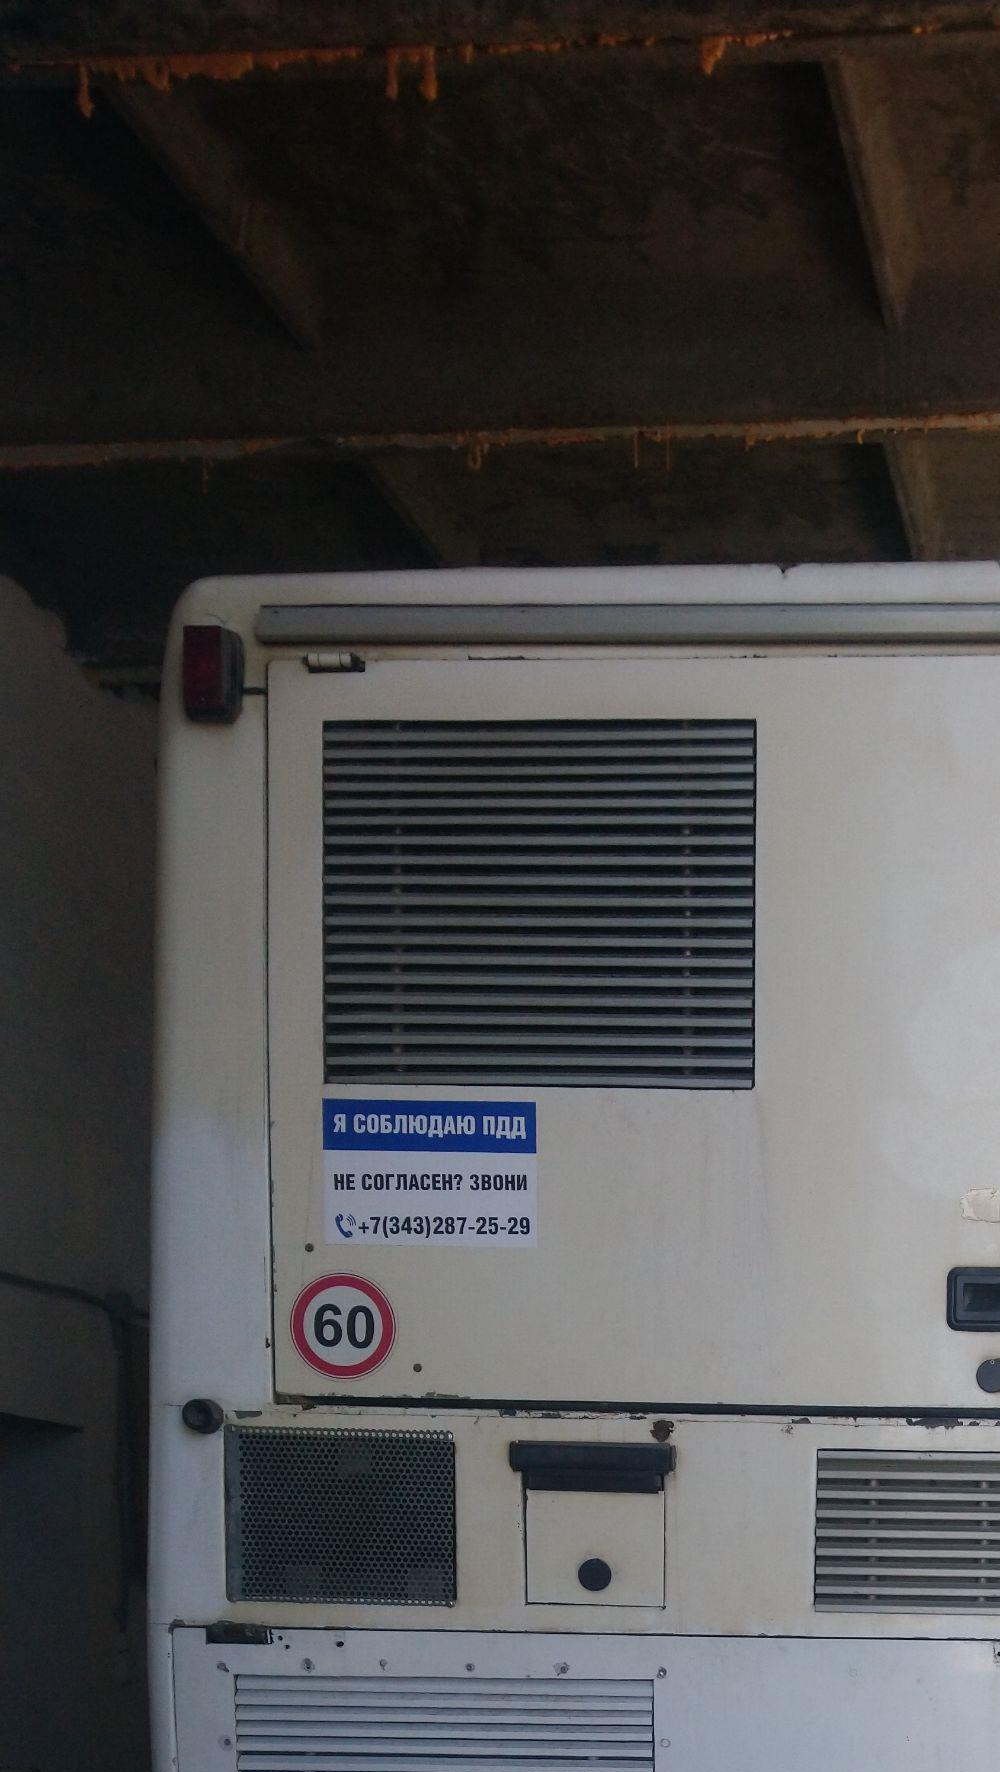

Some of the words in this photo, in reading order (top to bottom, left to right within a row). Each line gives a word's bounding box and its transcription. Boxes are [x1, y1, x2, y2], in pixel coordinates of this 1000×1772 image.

[333, 1113, 346, 1133] Я
[353, 1113, 476, 1138] СОБЛЮДАЮ
[482, 1115, 527, 1139] ПДД
[333, 1173, 356, 1191] НЕ
[361, 1173, 463, 1191] СОГЛАСЕН?
[469, 1173, 528, 1191] ЗВОНИ
[357, 1215, 531, 1239] +7(343)287-25-29
[313, 1303, 375, 1349] 60
